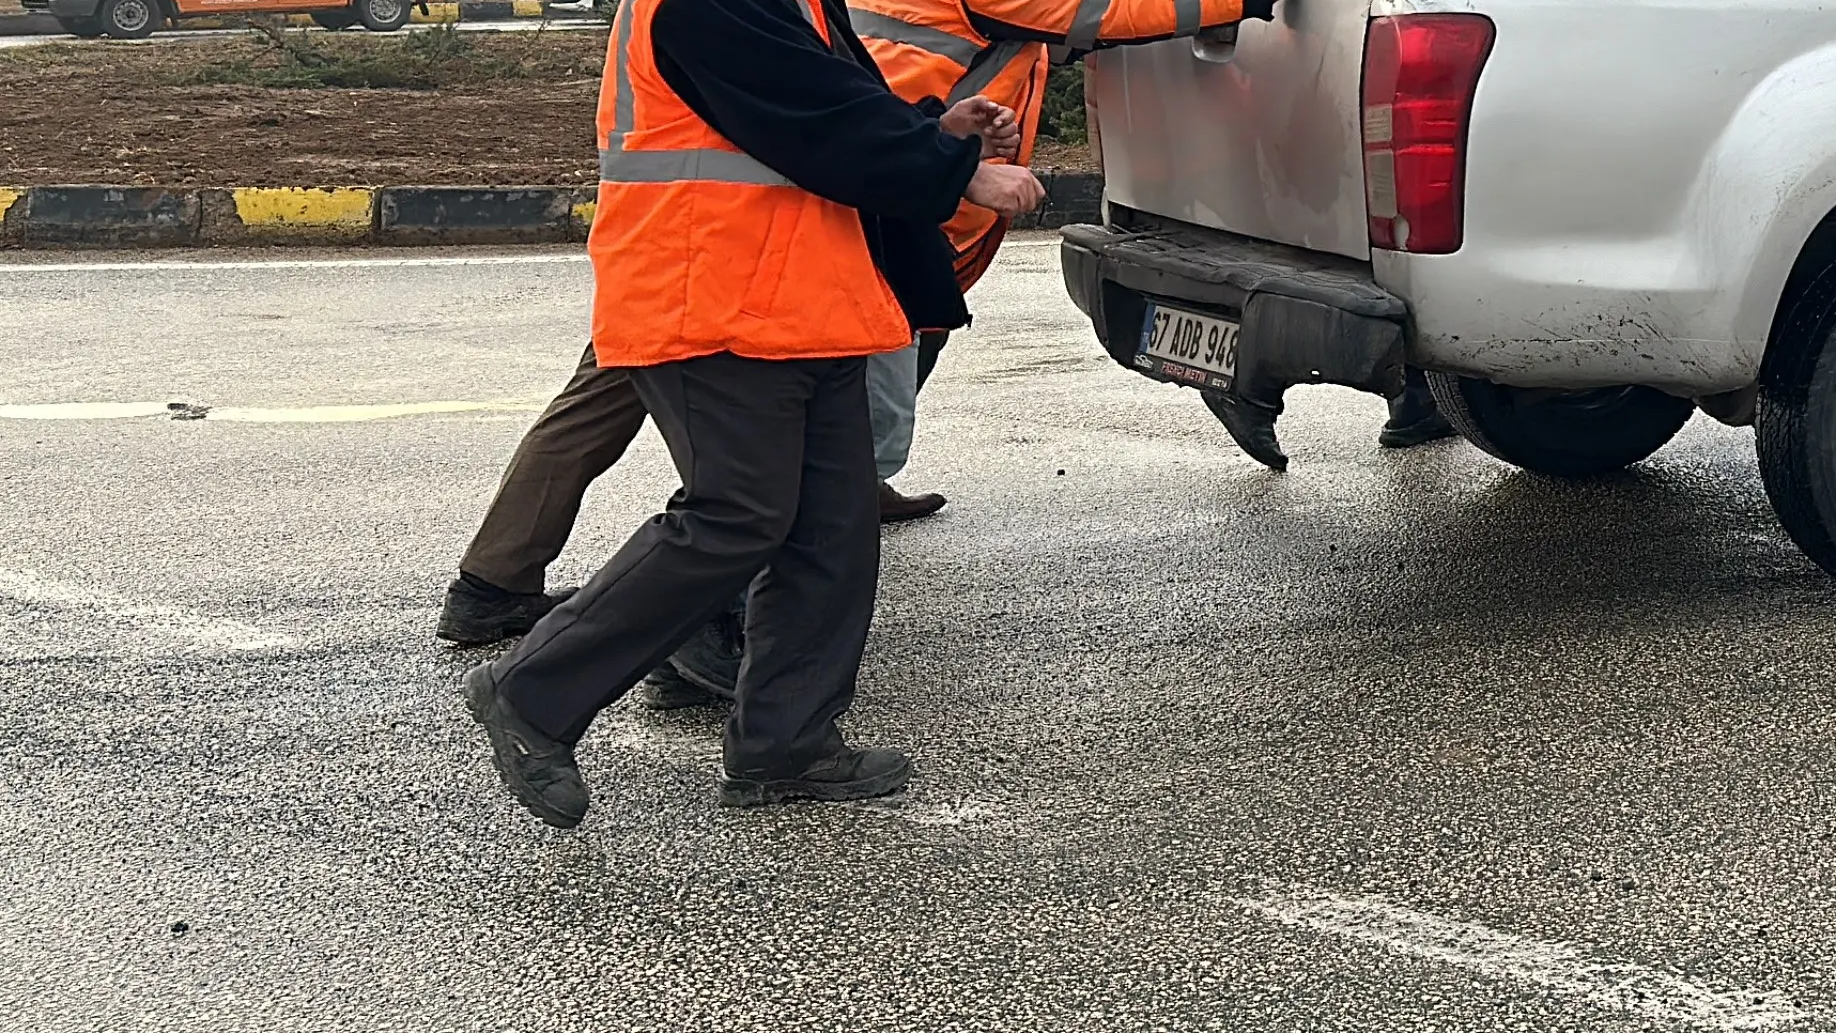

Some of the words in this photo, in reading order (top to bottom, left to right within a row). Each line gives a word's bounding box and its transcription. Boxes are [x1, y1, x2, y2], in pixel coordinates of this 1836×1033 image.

[1149, 312, 1170, 350] 67
[1169, 317, 1203, 360] ADB
[1205, 326, 1238, 368] 948
